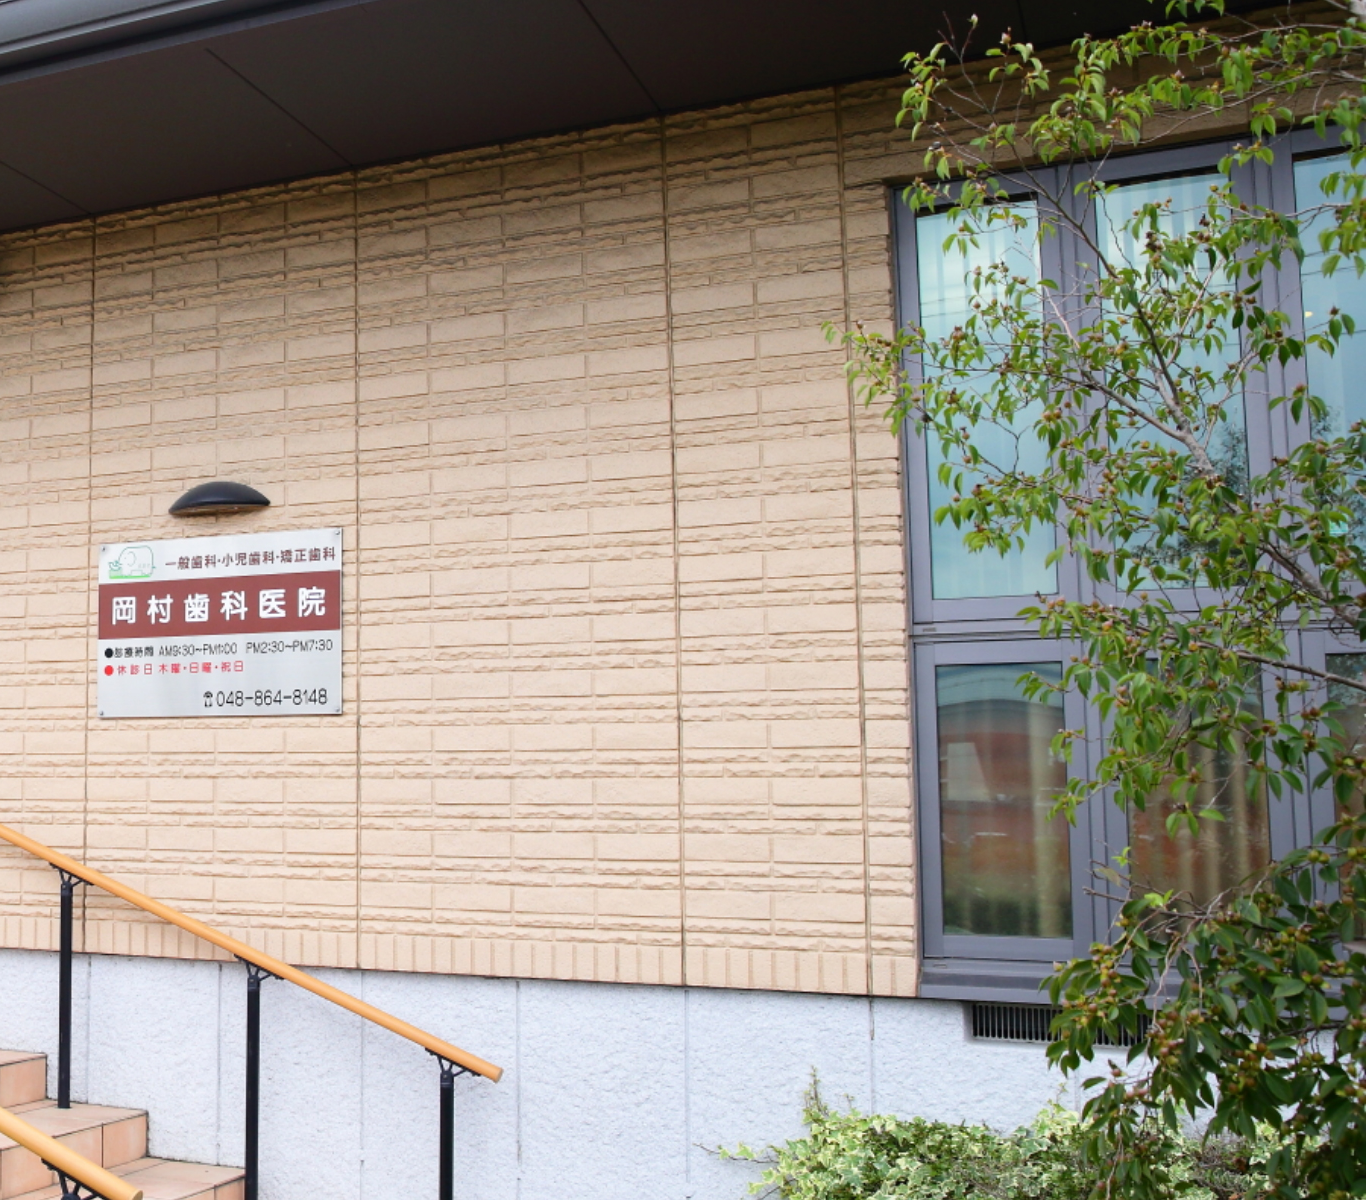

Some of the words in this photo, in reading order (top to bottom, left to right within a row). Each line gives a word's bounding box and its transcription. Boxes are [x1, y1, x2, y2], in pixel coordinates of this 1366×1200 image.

[112, 586, 326, 625] 岡村歯科医院
[117, 663, 152, 675] 休診日
[216, 688, 328, 707] 048-864-8148
